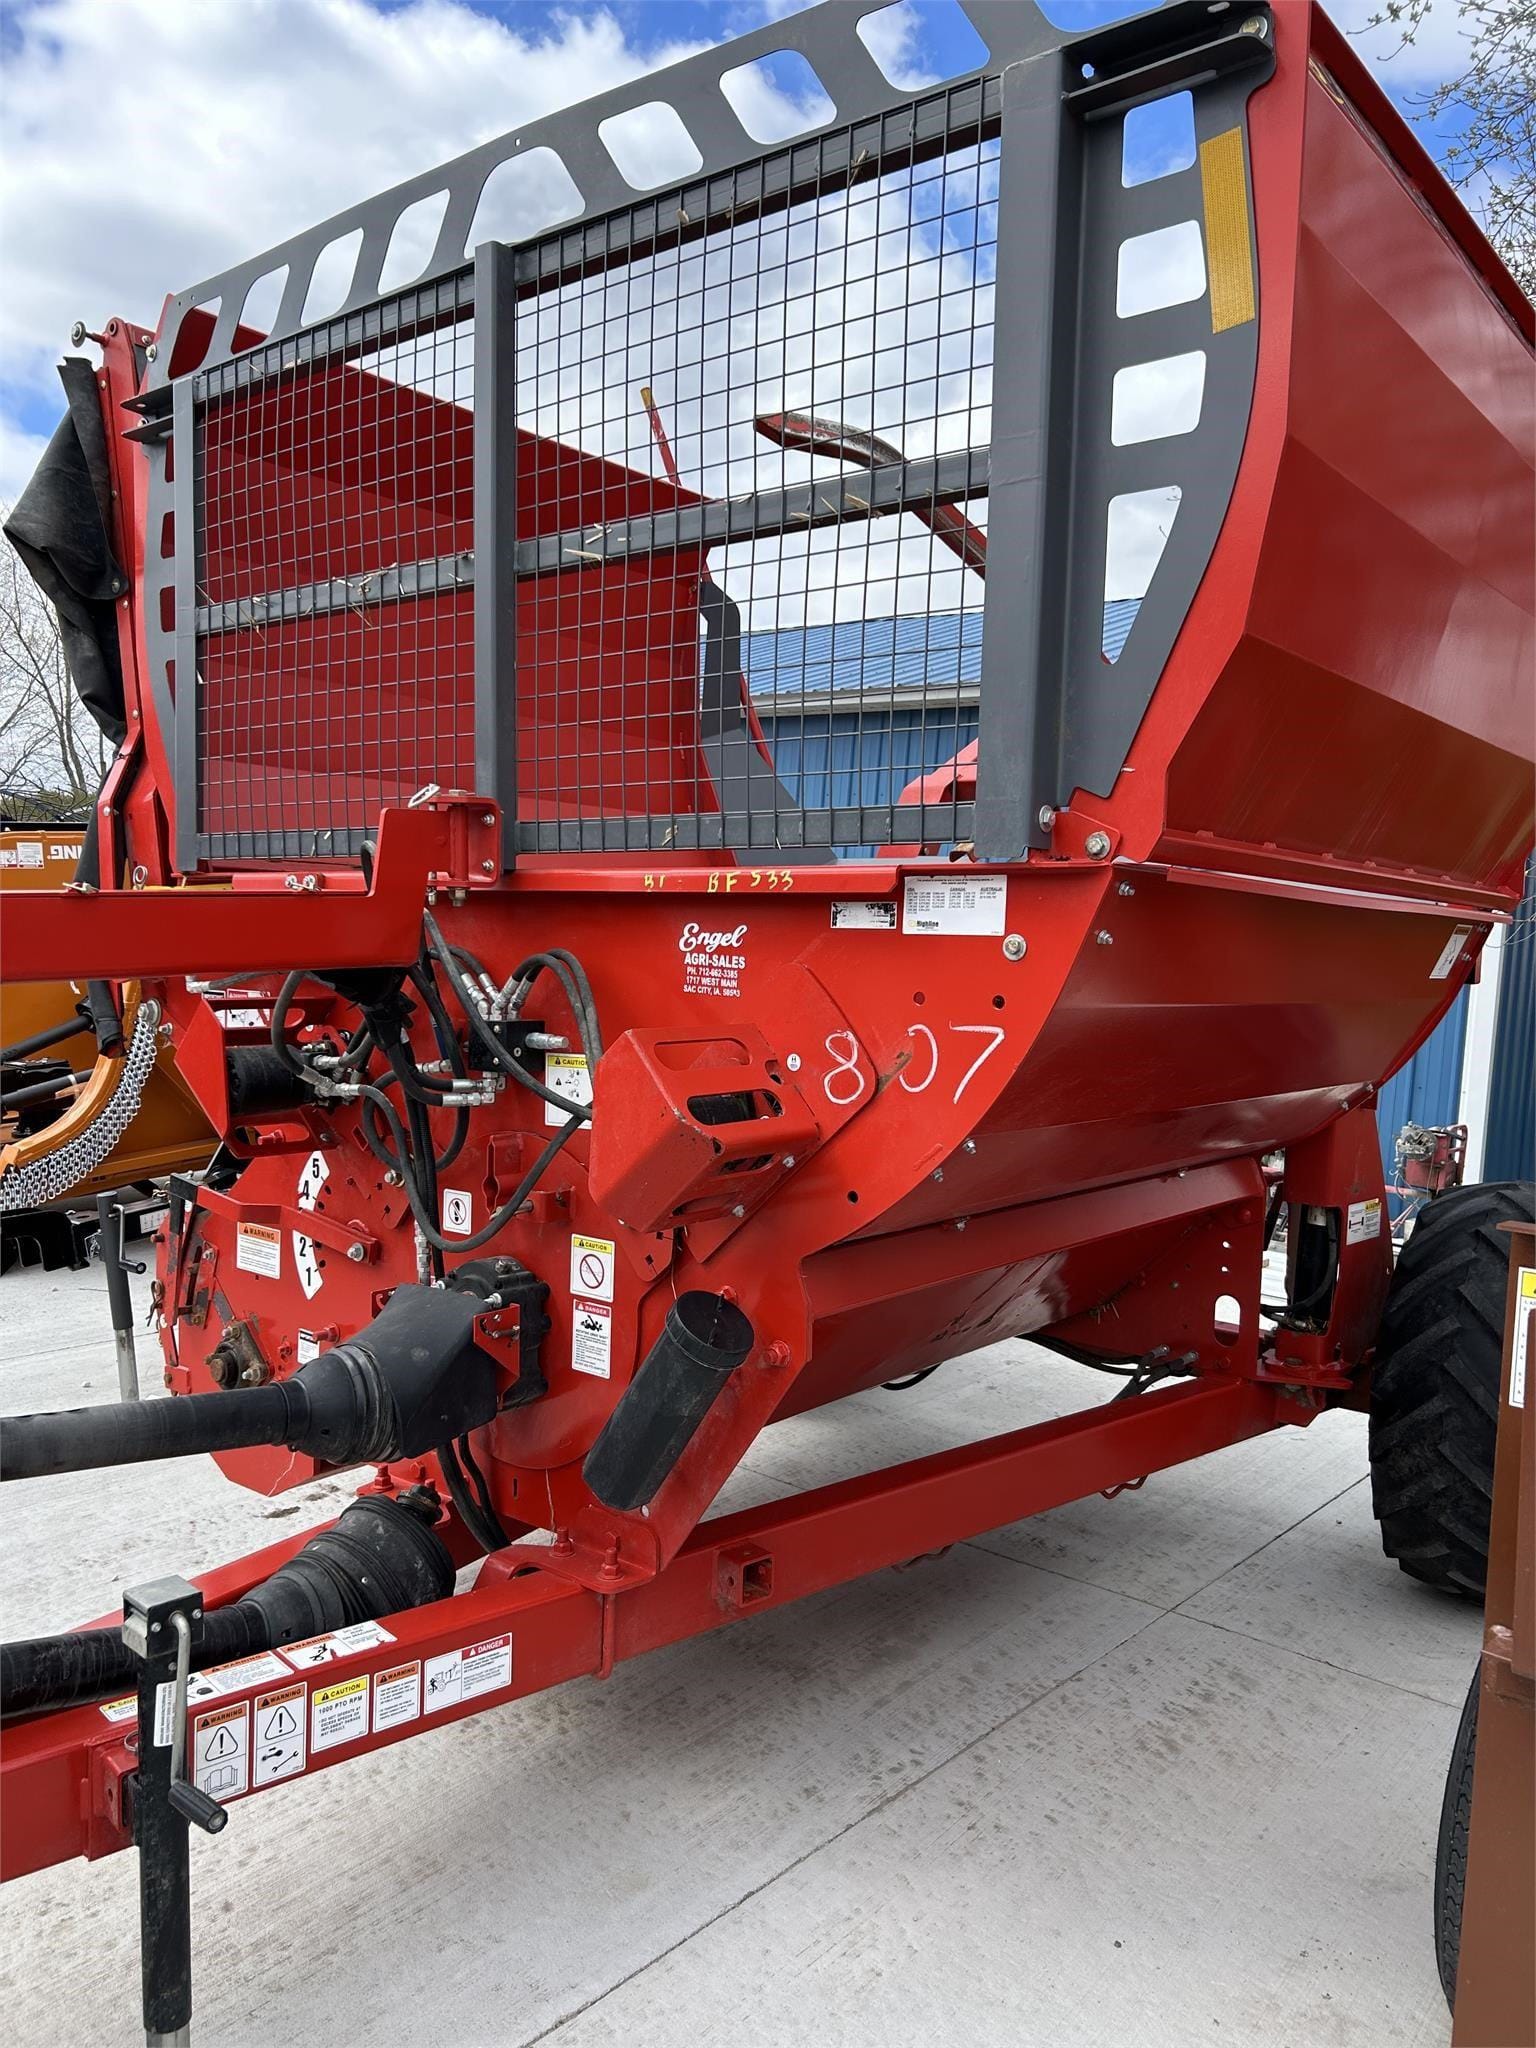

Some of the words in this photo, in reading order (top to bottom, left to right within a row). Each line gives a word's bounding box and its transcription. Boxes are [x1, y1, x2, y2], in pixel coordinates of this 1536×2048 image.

[679, 922, 748, 952] Engel
[684, 952, 746, 969] AGRI-SALES
[686, 966, 698, 976] PH.
[683, 984, 697, 993] SAC
[686, 975, 700, 985] 1717
[701, 977, 720, 987] WEST
[720, 978, 738, 988] MAIN
[562, 1058, 588, 1067] CAUTIO
[311, 1158, 320, 1179] 5
[302, 1180, 310, 1200] 4
[250, 1228, 275, 1240] WARNING
[299, 1236, 306, 1258] 2
[585, 1241, 608, 1251] CAUTION
[305, 1266, 312, 1287] 1
[584, 1305, 608, 1315] DANGER
[295, 1635, 331, 1647] WARNING
[477, 1639, 504, 1653] DANGER
[223, 1655, 261, 1669] WARNING
[388, 1666, 416, 1680] WARNING
[270, 1688, 301, 1703] WARNING
[330, 1683, 361, 1697] CAUTION
[318, 1704, 333, 1714] 1000
[334, 1700, 348, 1709] PTO
[349, 1695, 363, 1704] RPM
[211, 1708, 243, 1723] WARNING
